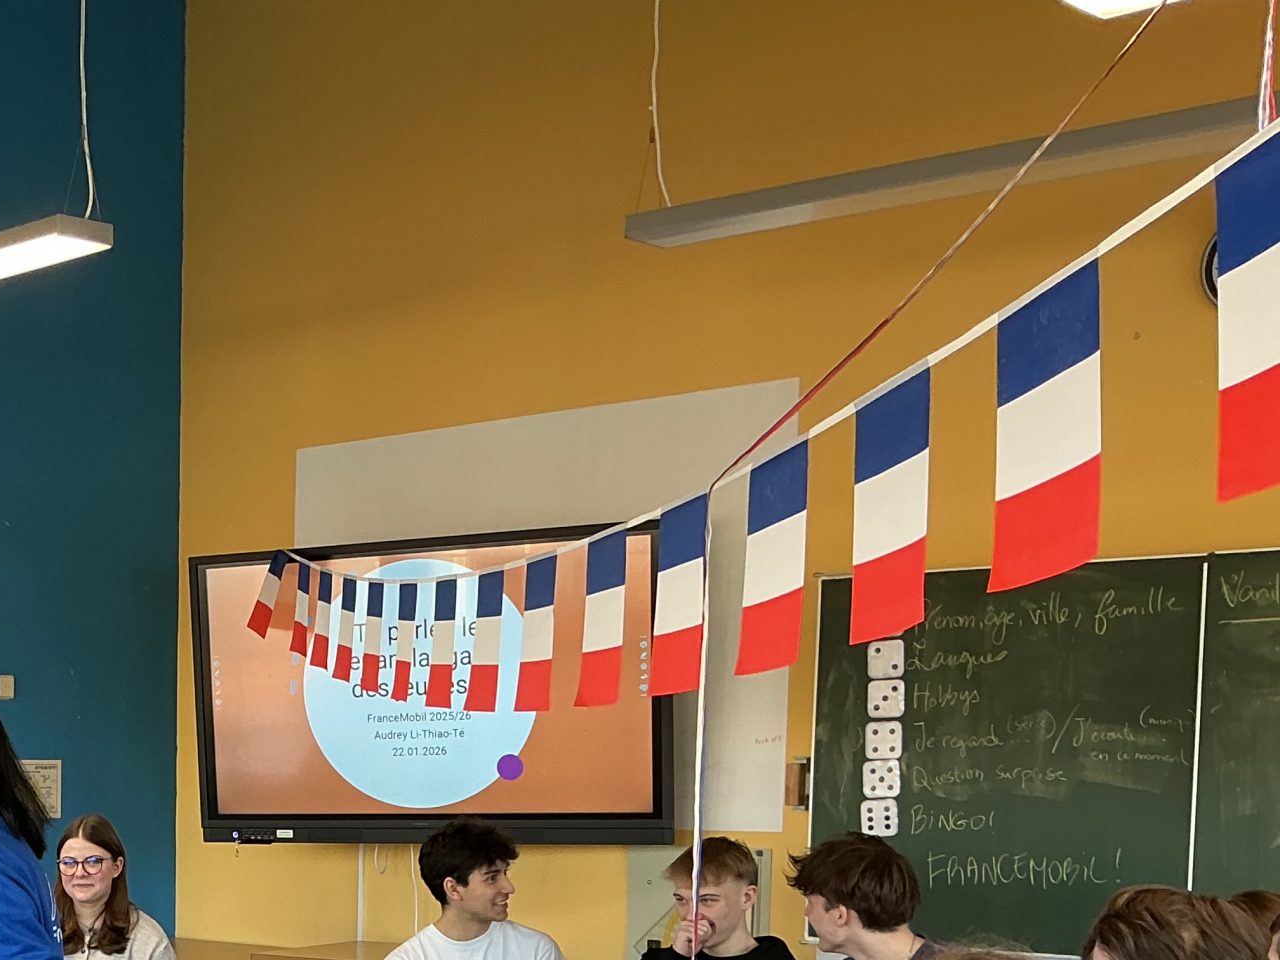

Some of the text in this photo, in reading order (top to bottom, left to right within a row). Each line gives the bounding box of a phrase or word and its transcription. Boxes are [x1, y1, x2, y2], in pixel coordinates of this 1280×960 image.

[1094, 586, 1184, 635] famille
[367, 711, 472, 724] FranceMobil 2025/26
[374, 728, 465, 742] Audrey Li-Thiao-Té
[392, 747, 447, 757] 22.01.2026
